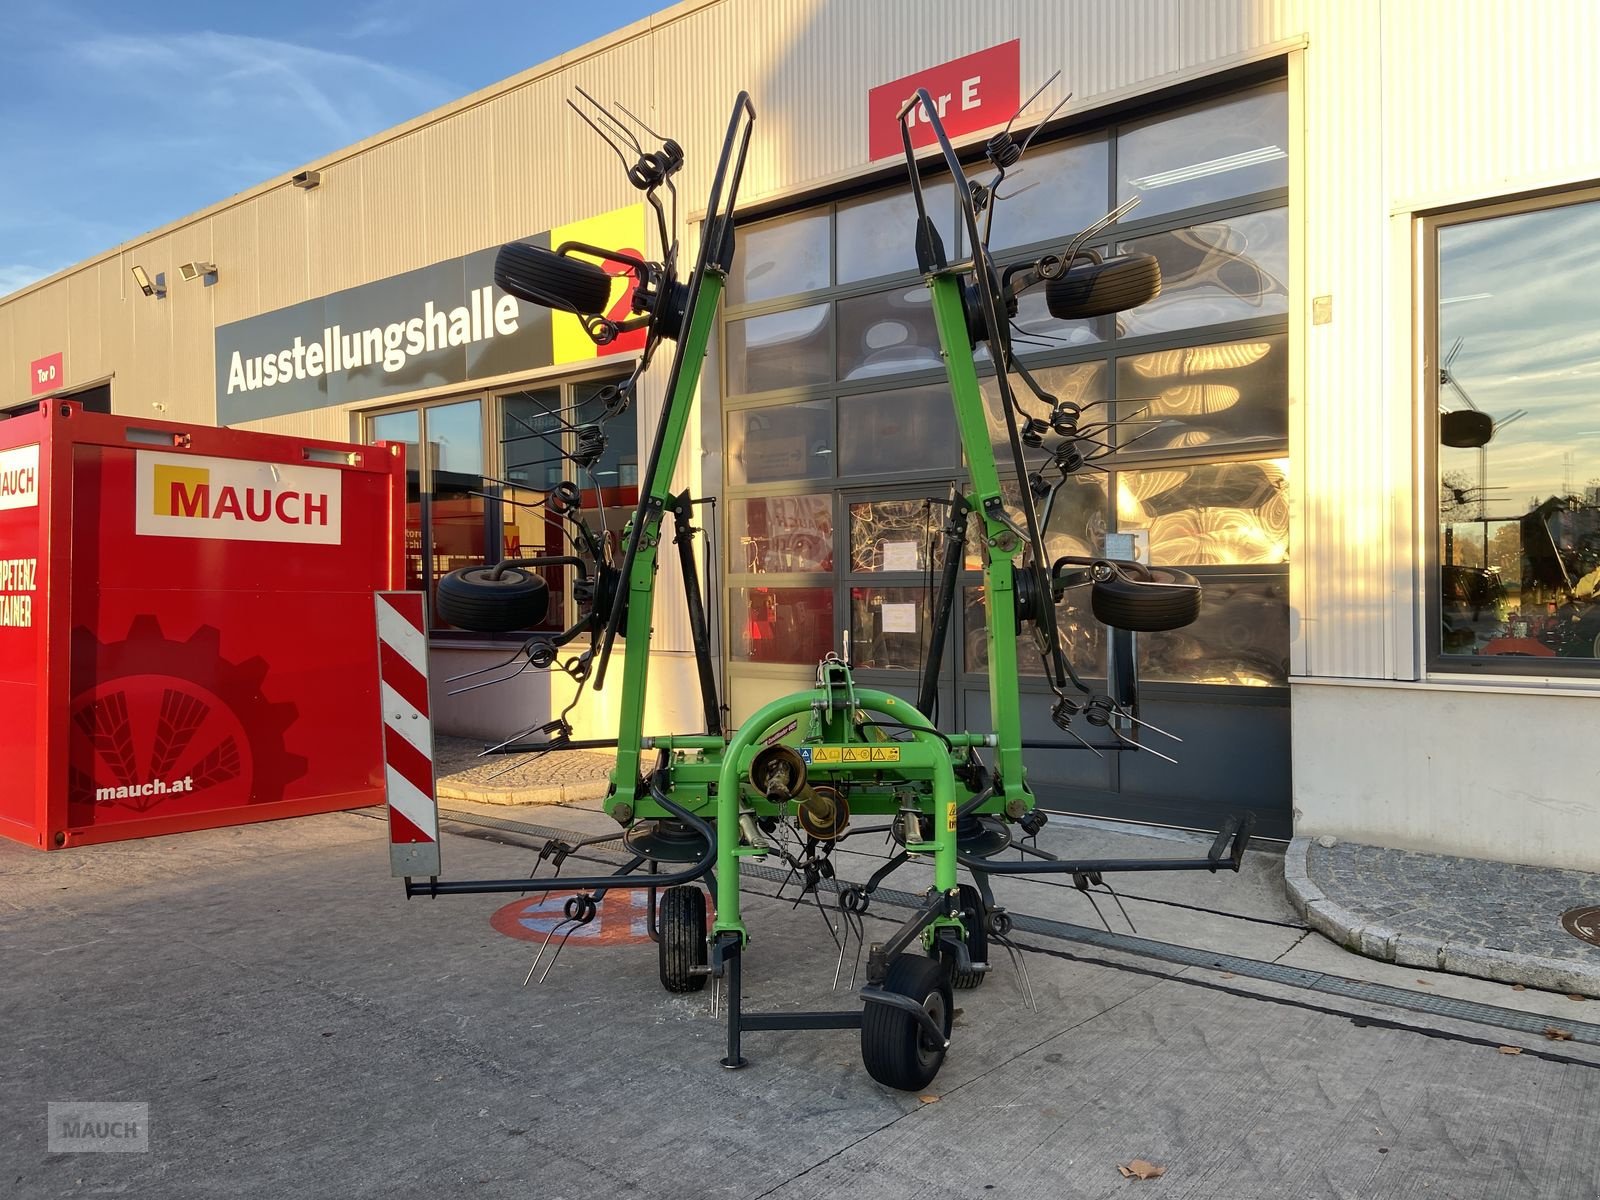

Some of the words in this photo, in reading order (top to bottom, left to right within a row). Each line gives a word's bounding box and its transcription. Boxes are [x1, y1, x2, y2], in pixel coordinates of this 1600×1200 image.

[961, 75, 982, 112] E
[227, 285, 520, 395] Ausstellungshalle
[37, 369, 49, 384] Tor
[50, 365, 56, 380] D
[0, 467, 34, 497] AUCH
[171, 481, 328, 526] MAUCH
[96, 776, 193, 801] mauch.at
